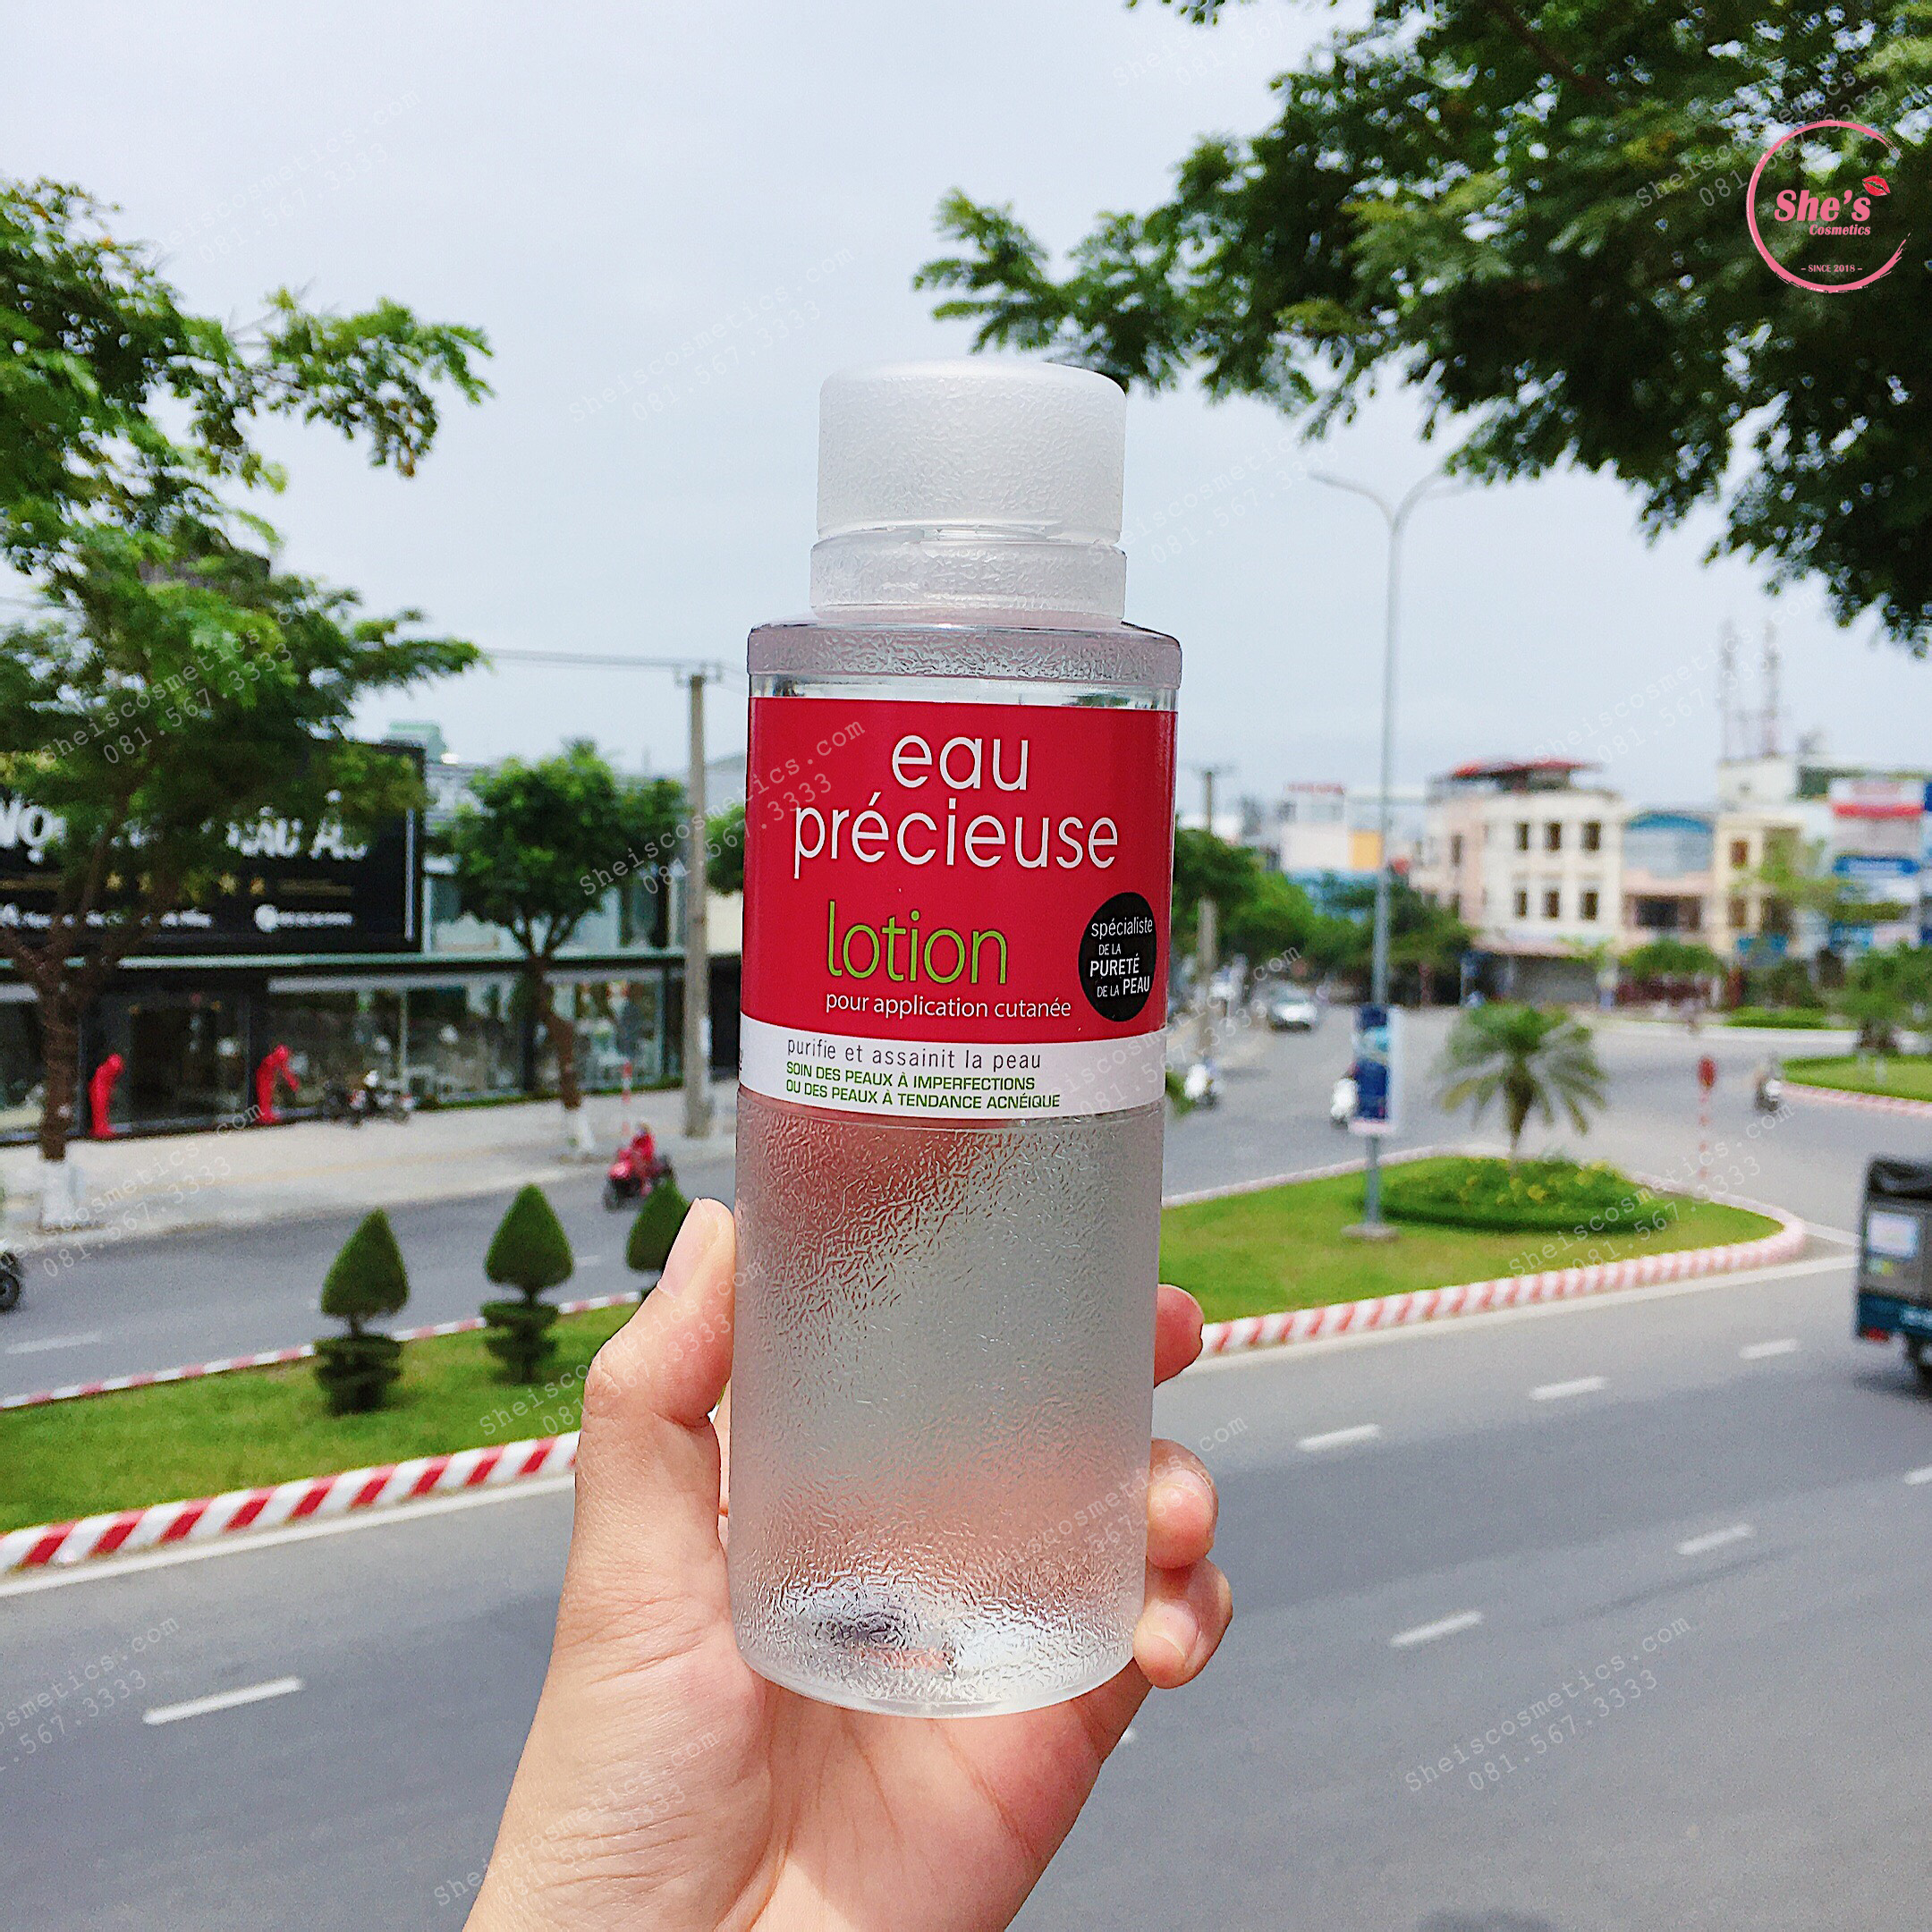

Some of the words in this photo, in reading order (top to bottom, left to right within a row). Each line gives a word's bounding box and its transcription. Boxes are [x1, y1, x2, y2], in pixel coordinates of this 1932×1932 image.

[892, 734, 1029, 791] eau
[793, 792, 1118, 879] précieuse
[828, 901, 1007, 984] lotion
[1091, 917, 1153, 940] spécialiste
[1098, 944, 1110, 956] DE
[1112, 944, 1122, 955] LA
[1089, 953, 1140, 977] PURETÉ
[1097, 986, 1108, 997] DE
[1110, 985, 1120, 996] LA
[1123, 976, 1150, 996] PEAU
[826, 993, 869, 1013] pour
[873, 995, 988, 1020] application
[994, 997, 1072, 1018] cutanée
[787, 1038, 836, 1060] purifie
[845, 1045, 862, 1063] et
[872, 1048, 955, 1069] assainit
[965, 1049, 982, 1069] la
[993, 1055, 1041, 1072] peau
[786, 1062, 812, 1078] SOIN
[816, 1066, 841, 1081] DES
[845, 1070, 893, 1087] PEAUX
[897, 1072, 909, 1088] À
[913, 1075, 1036, 1091] IMPERFECTIONS
[786, 1079, 801, 1094] OU
[804, 1082, 828, 1097] DES
[832, 1087, 878, 1104] PEAUX
[882, 1089, 894, 1106] À
[897, 1093, 982, 1109] TENDANCE
[987, 1093, 1061, 1109] ACNÉIQUE
